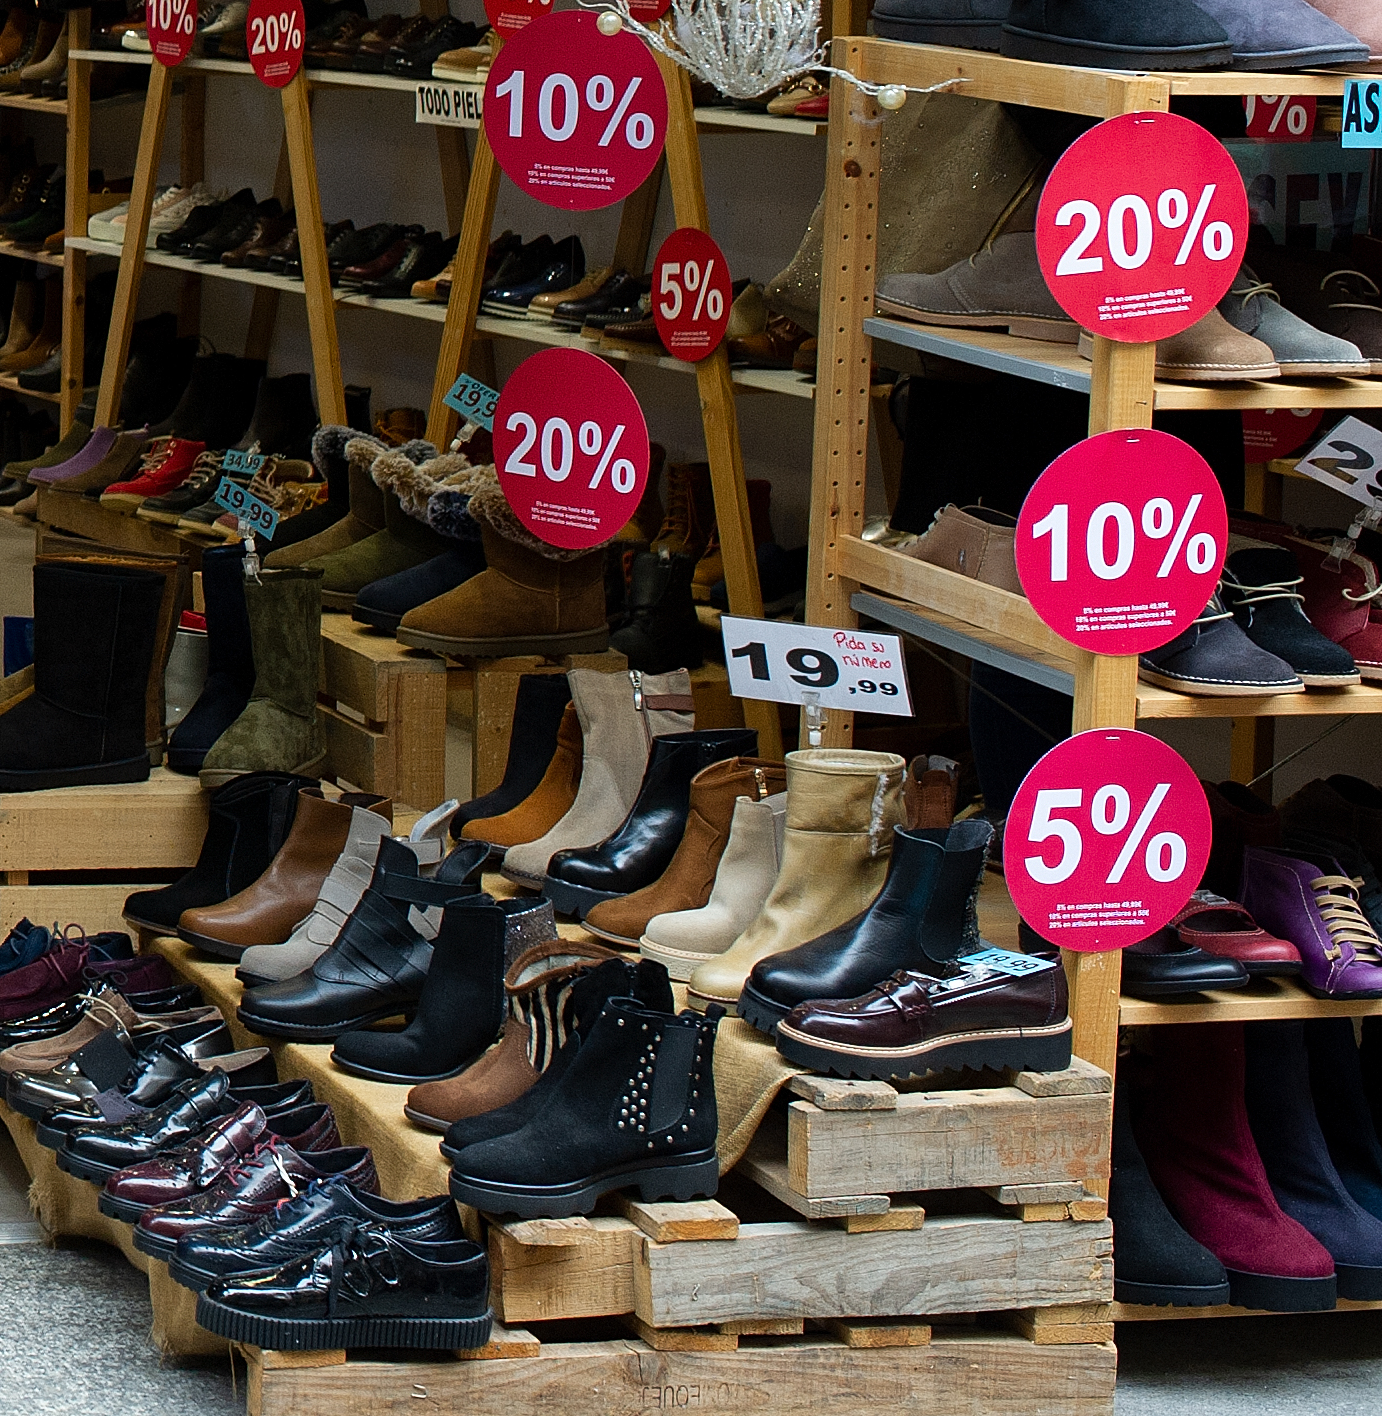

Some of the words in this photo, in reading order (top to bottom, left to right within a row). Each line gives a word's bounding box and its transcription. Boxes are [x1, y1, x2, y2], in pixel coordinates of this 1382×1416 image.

[252, 11, 301, 54] 20%
[418, 86, 449, 115] TODO
[454, 89, 483, 120] PIEL
[496, 71, 654, 149] 10%
[1343, 82, 1382, 134] AS
[1056, 184, 1233, 275] 20%
[660, 260, 723, 320] 5%
[453, 384, 498, 418] 19,9
[505, 412, 635, 493] 20%
[1033, 494, 1216, 581] 10%
[833, 632, 866, 650] Pida
[1025, 784, 1186, 884] 5%
